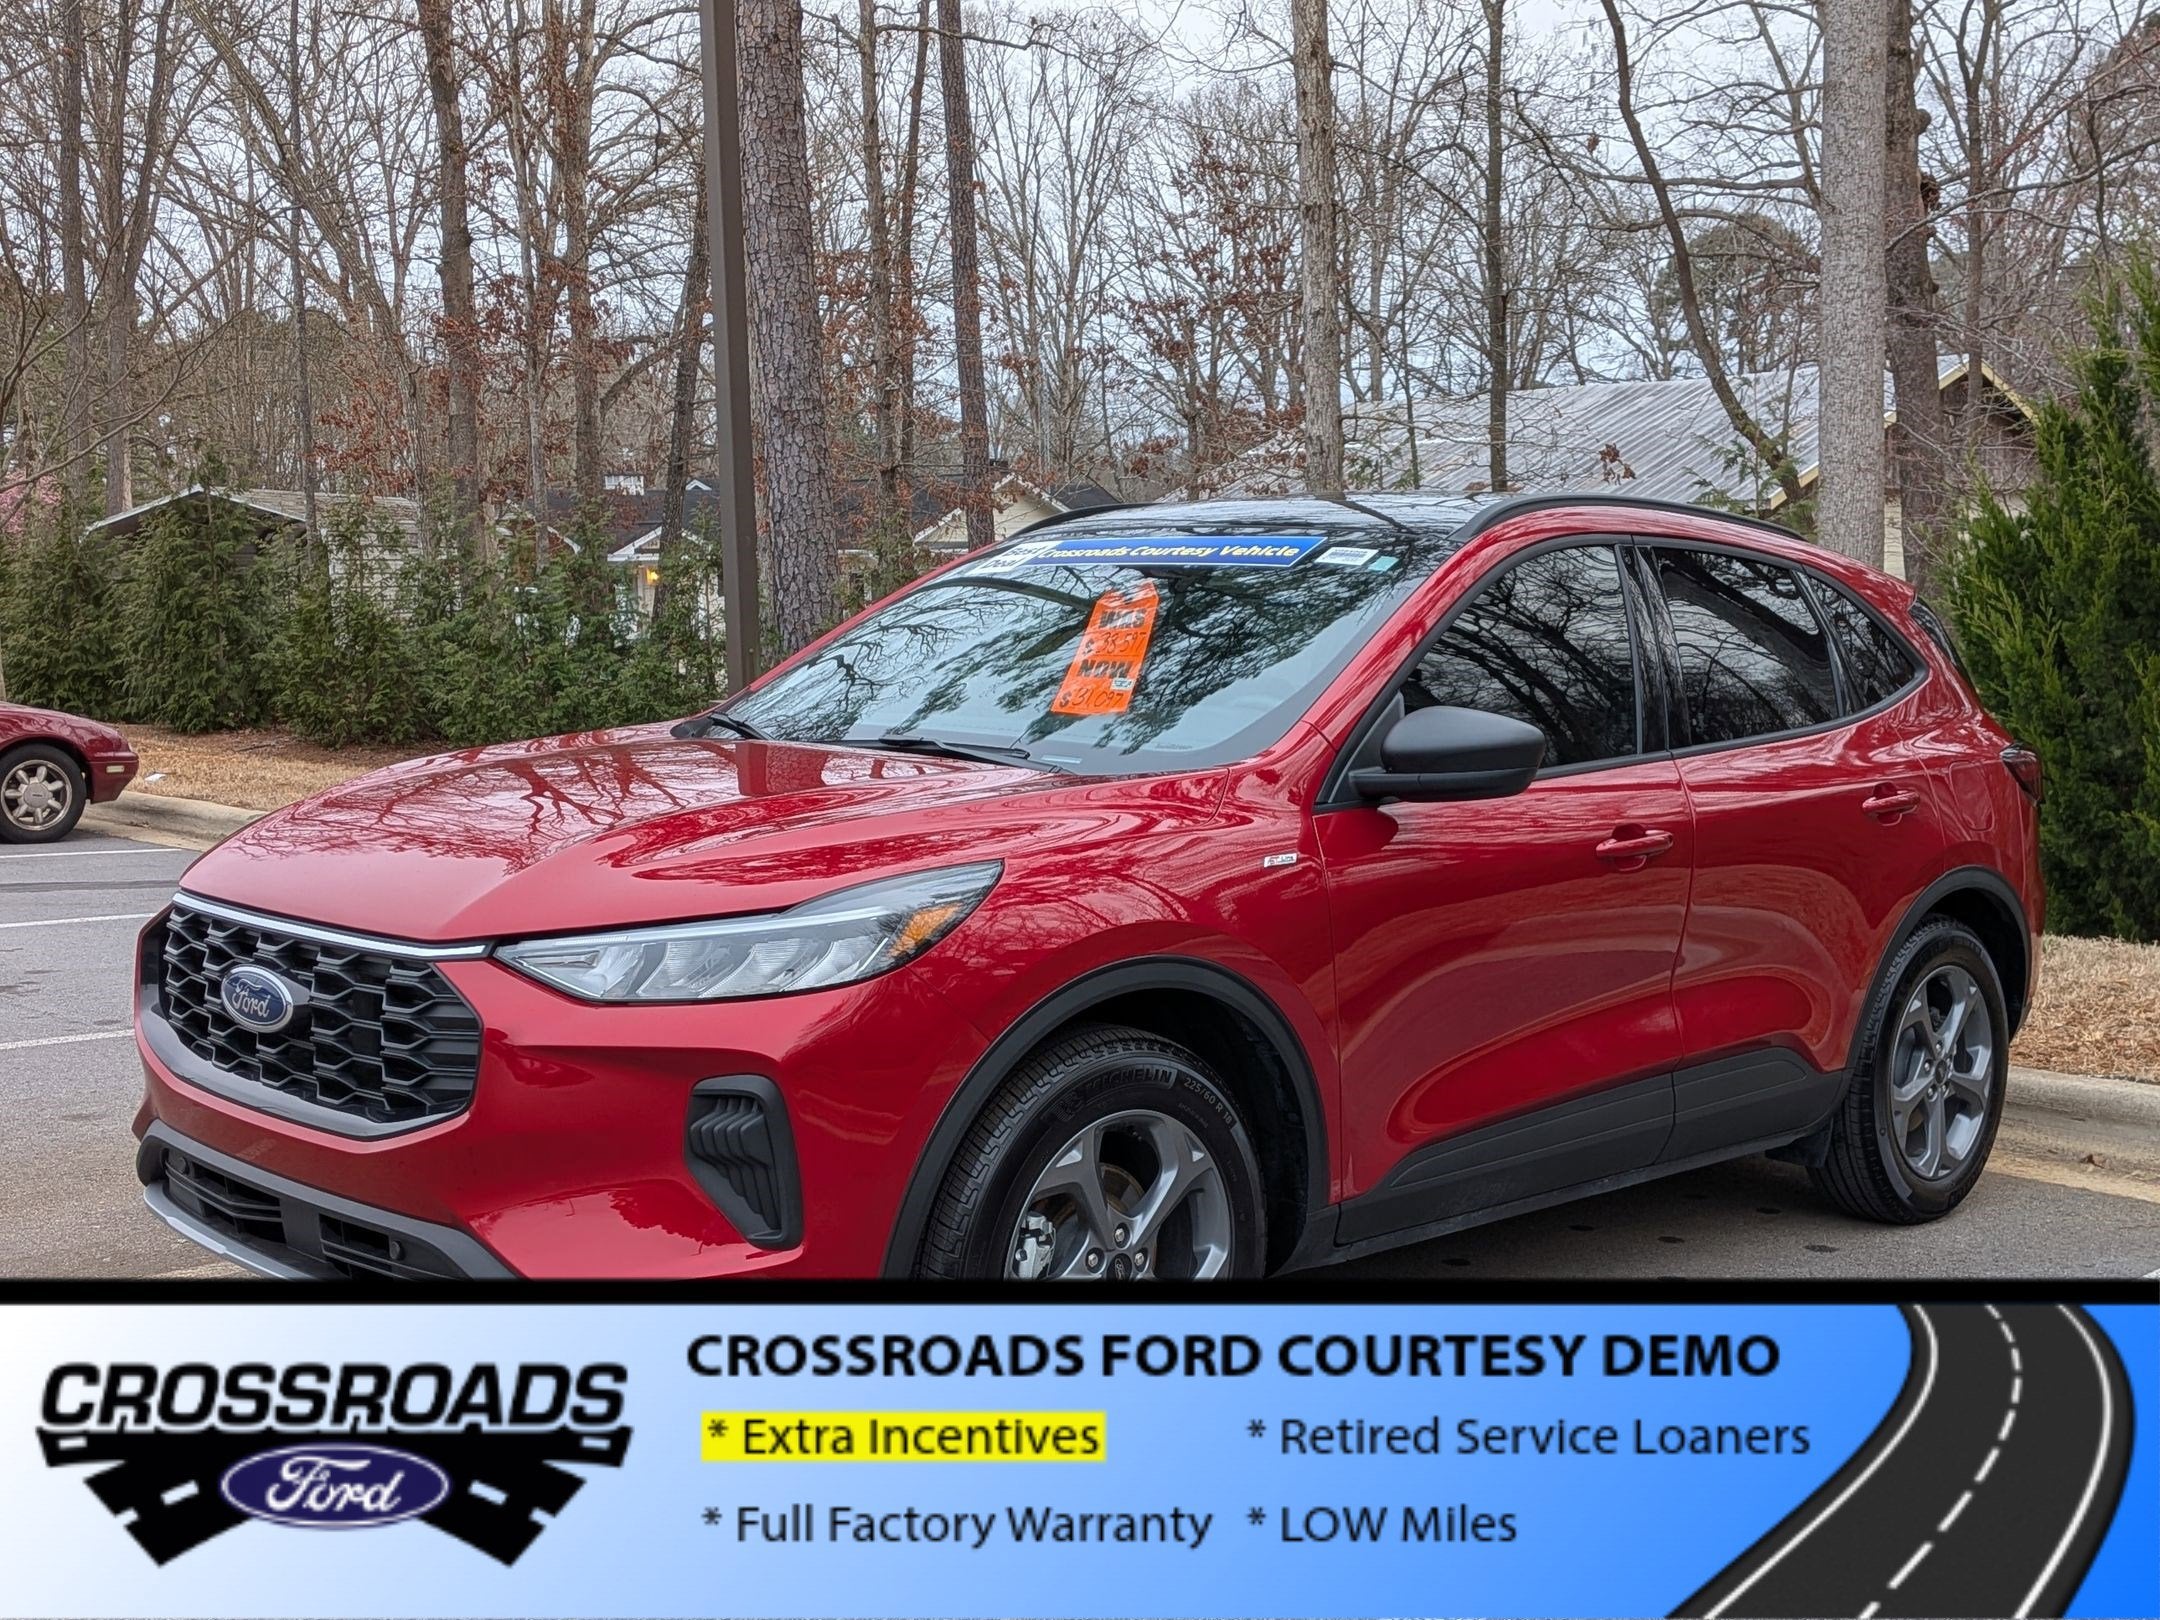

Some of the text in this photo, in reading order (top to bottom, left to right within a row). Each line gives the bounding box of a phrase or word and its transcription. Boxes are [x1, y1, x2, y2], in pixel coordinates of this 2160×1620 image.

[1038, 546, 1300, 559] Crossroads Courtesy Vehicle
[1079, 659, 1134, 678] NOW
[231, 978, 271, 1018] Ford
[1183, 1077, 1215, 1104] 225/60
